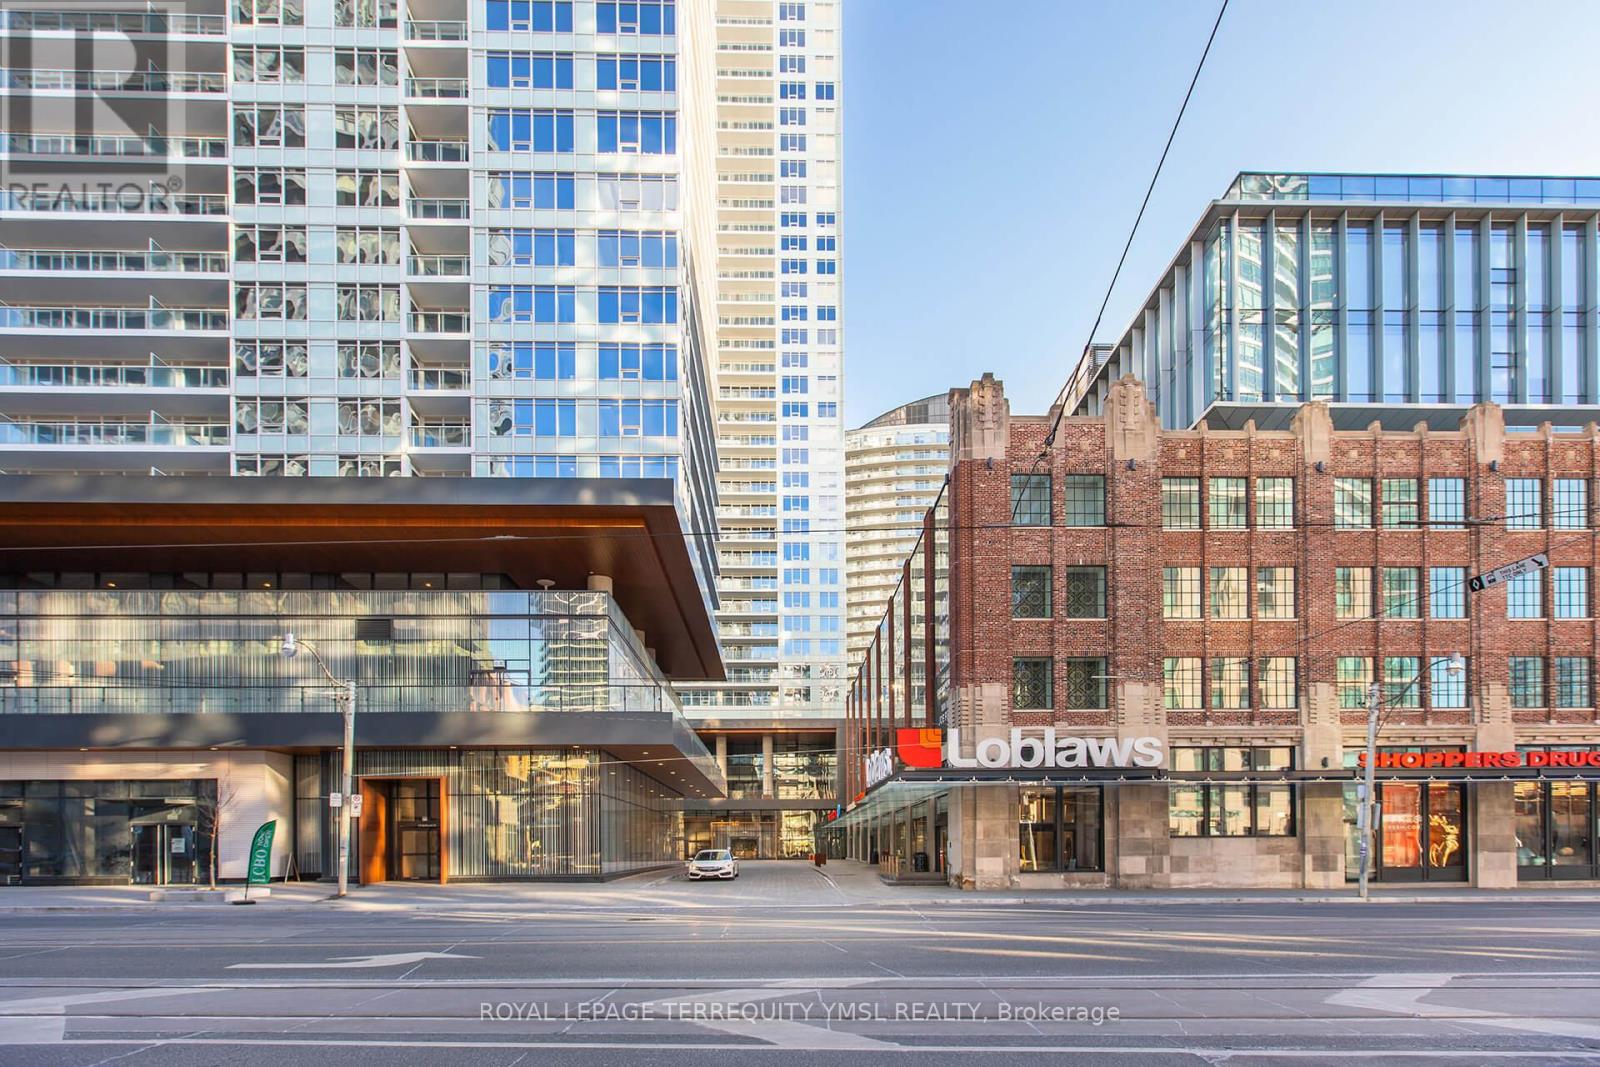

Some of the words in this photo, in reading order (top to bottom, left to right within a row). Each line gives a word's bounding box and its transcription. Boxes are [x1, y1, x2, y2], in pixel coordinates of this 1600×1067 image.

[947, 727, 1163, 768] Loblaws
[1357, 751, 1521, 768] SHOPPERS
[252, 849, 268, 882] LCBO
